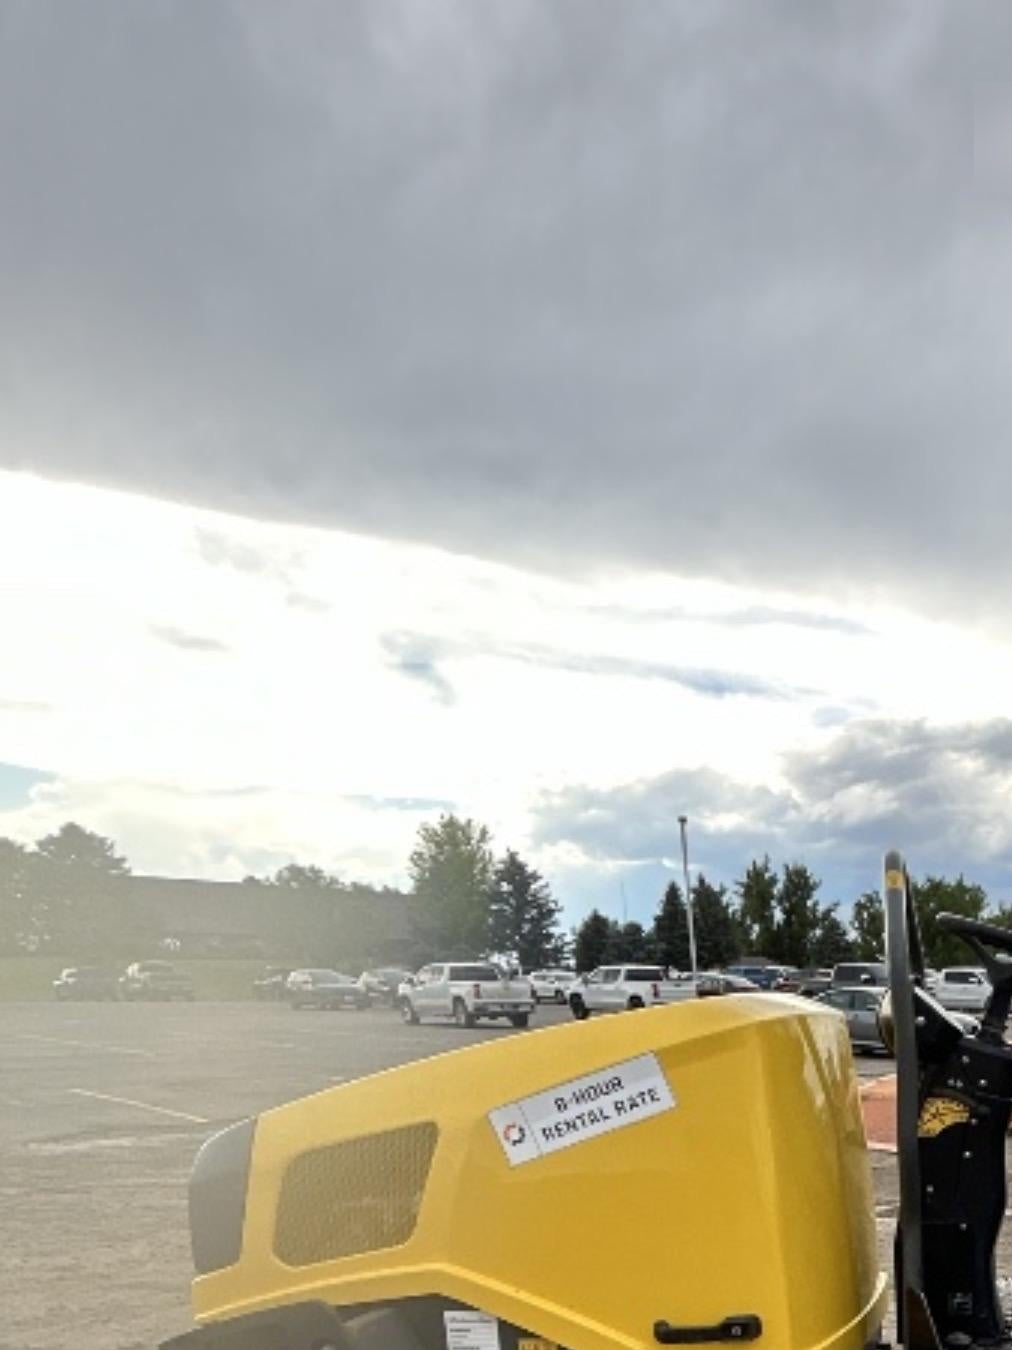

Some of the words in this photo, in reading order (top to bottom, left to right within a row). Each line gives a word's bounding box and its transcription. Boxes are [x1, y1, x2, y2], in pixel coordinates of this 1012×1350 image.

[542, 1107, 612, 1141] RENTAL
[615, 1088, 661, 1116] RATE
[554, 1076, 624, 1112] 8-HOUR
